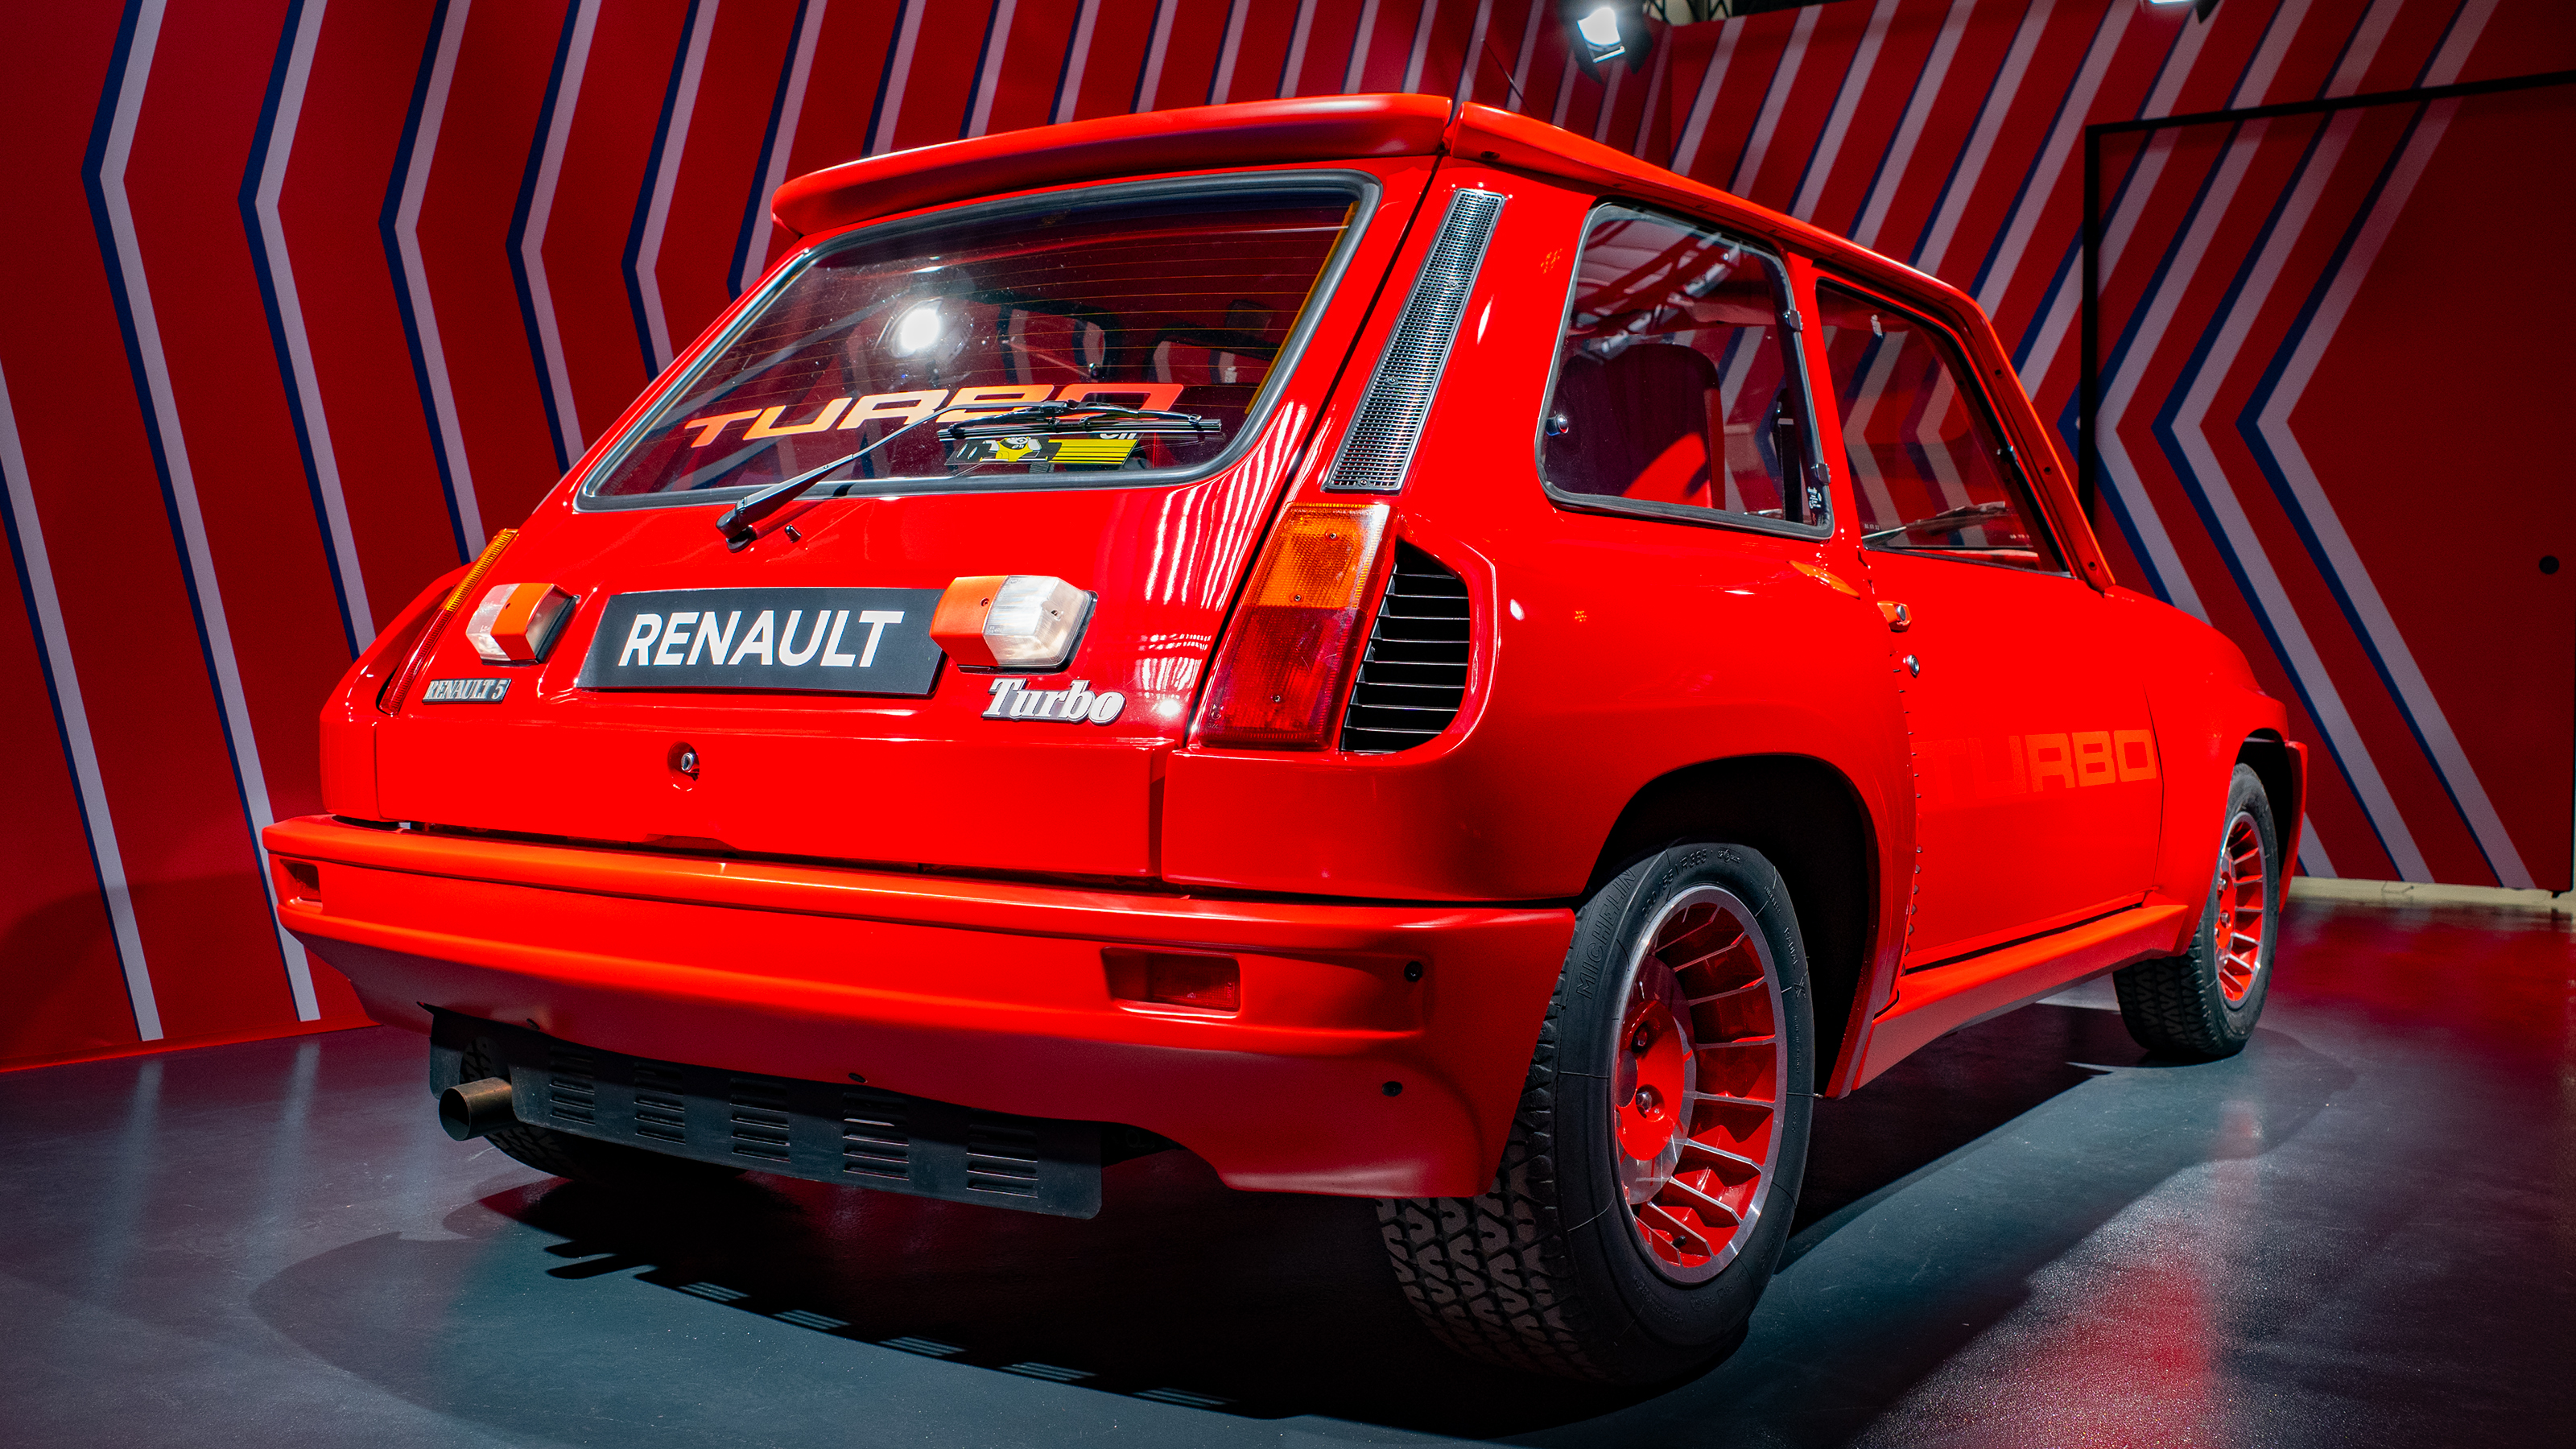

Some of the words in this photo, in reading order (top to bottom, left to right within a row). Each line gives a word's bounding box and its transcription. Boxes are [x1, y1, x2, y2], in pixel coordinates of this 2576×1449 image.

[684, 383, 1184, 447] TURBO
[618, 609, 905, 667] RENAULT
[423, 679, 494, 700] RENAULT
[491, 679, 507, 700] 5
[982, 678, 1126, 725] Turbo
[1909, 729, 2157, 805] TURBO
[1575, 865, 1636, 1000] MICHELIN
